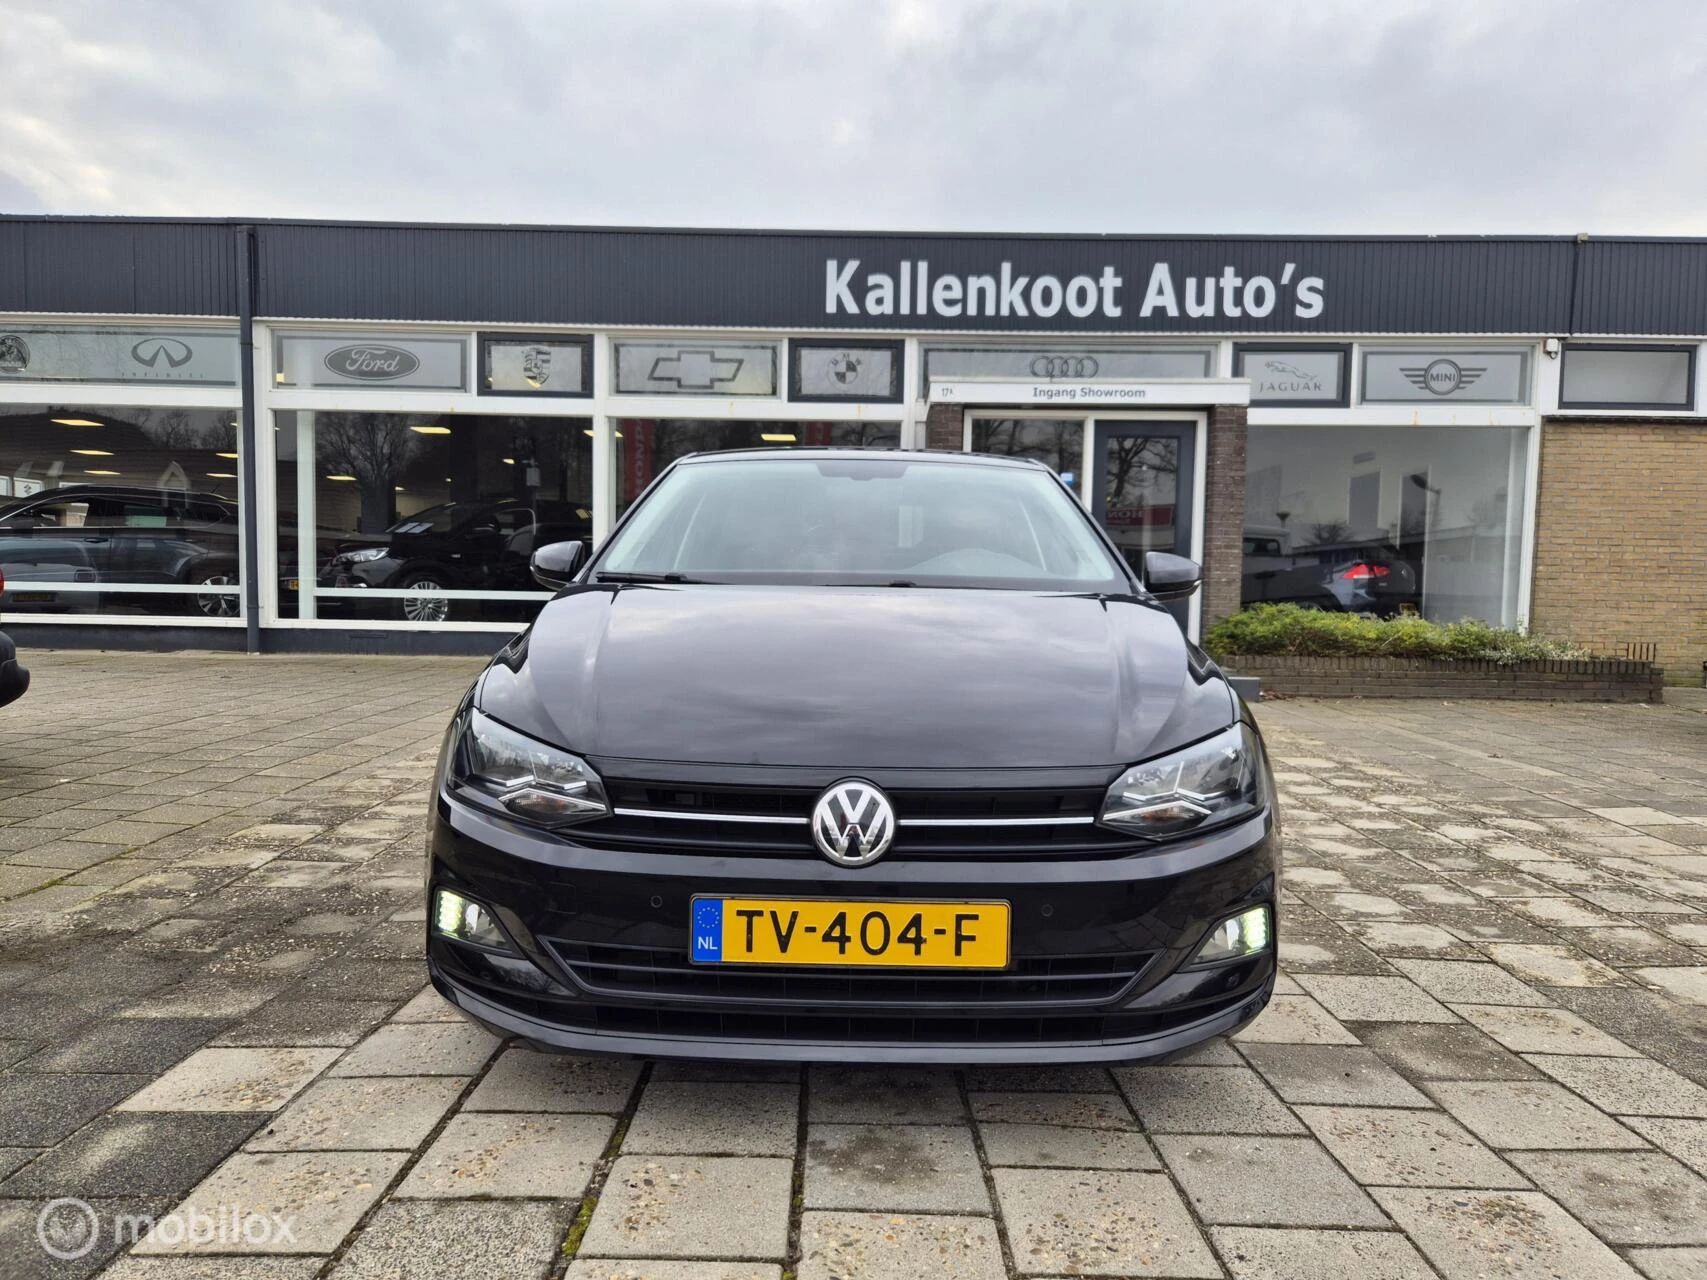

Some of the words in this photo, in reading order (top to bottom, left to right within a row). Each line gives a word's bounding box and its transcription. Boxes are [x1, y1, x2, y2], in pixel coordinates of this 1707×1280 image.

[825, 259, 1122, 318] Kallenkoot
[1139, 262, 1325, 319] Auto's
[346, 348, 400, 372] Ford
[1429, 372, 1456, 382] MINI
[1033, 387, 1076, 400] Ingang
[1080, 387, 1145, 398] Showroom
[1259, 381, 1322, 392] JAGUAR
[735, 909, 980, 957] TV-404-F
[698, 935, 718, 951] NL
